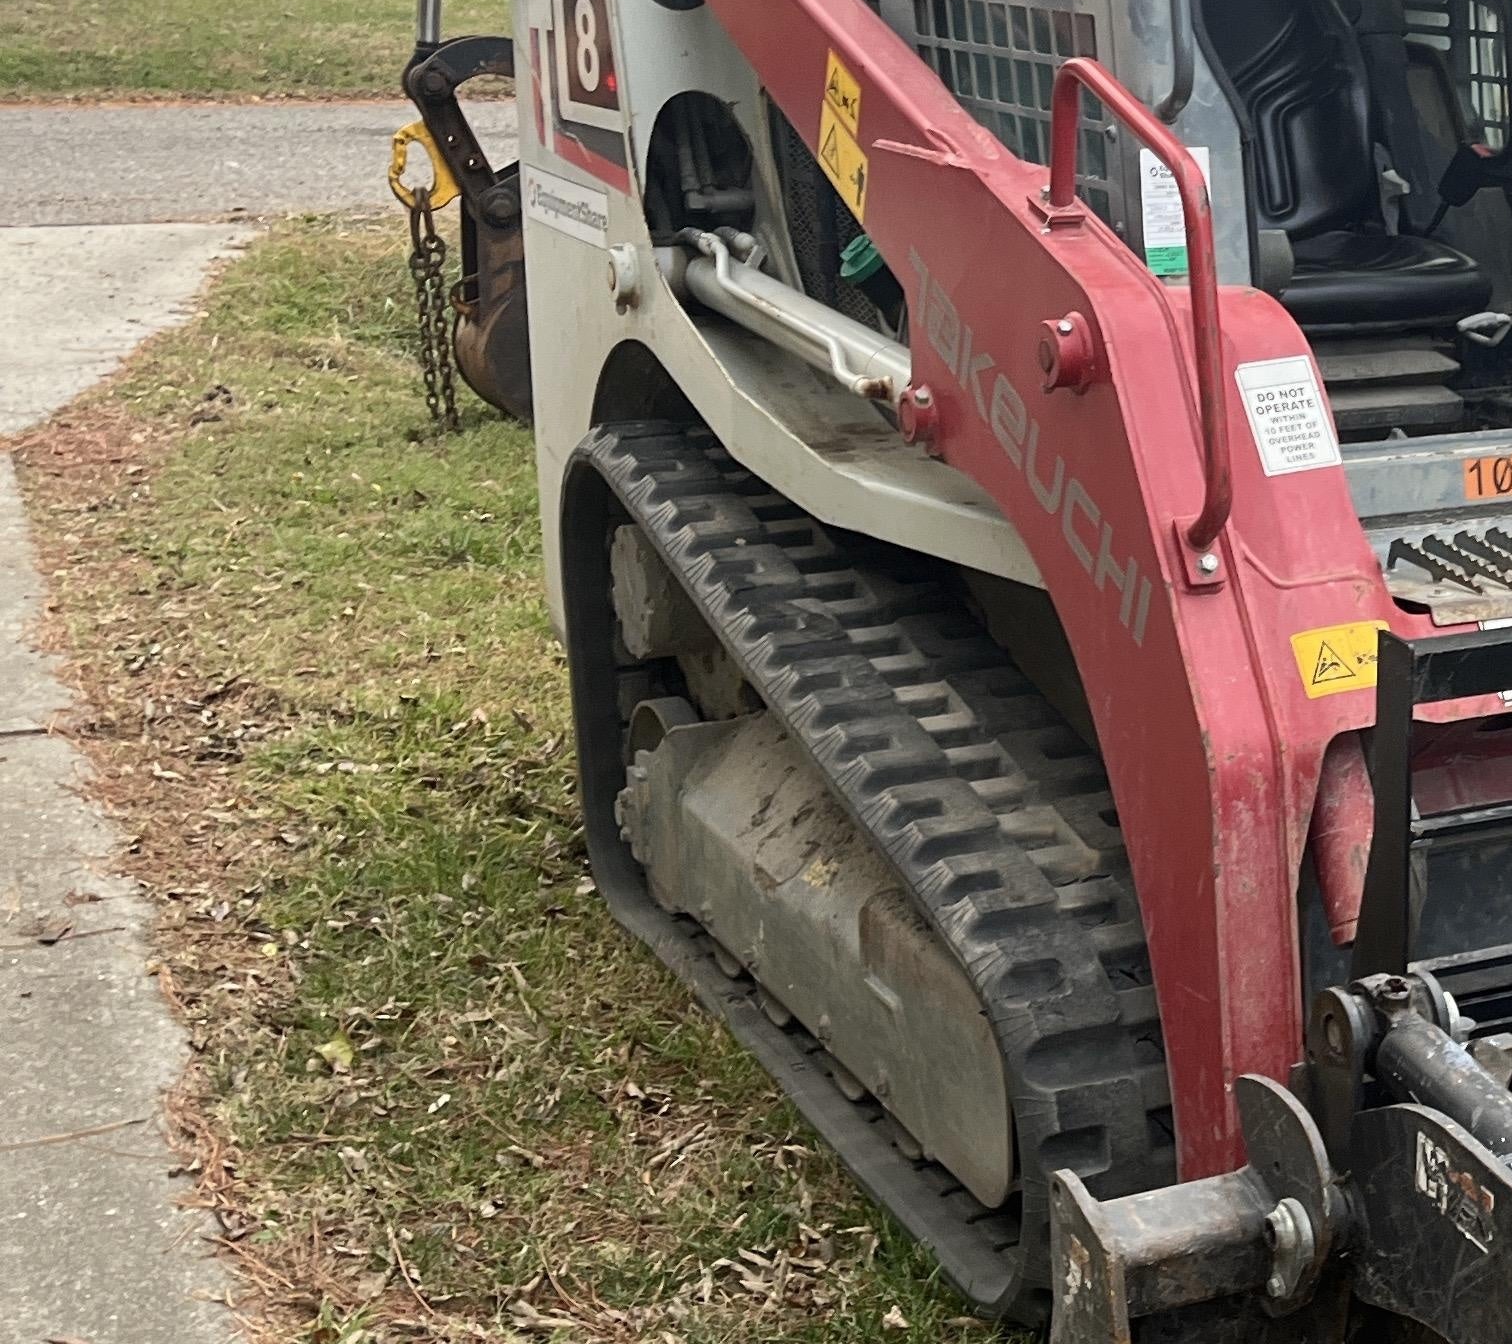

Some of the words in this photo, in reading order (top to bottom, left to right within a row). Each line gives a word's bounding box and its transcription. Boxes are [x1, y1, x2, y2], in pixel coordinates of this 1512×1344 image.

[1256, 392, 1275, 403] DO
[1279, 387, 1305, 399] NOT
[1255, 398, 1316, 416] OPERATE
[1269, 412, 1307, 424] WITHIN
[1279, 423, 1302, 434] FEET
[1305, 421, 1318, 430] OF
[1268, 431, 1321, 446] OVERHEAD
[1280, 442, 1316, 454] POWER
[1286, 452, 1316, 463] LINES
